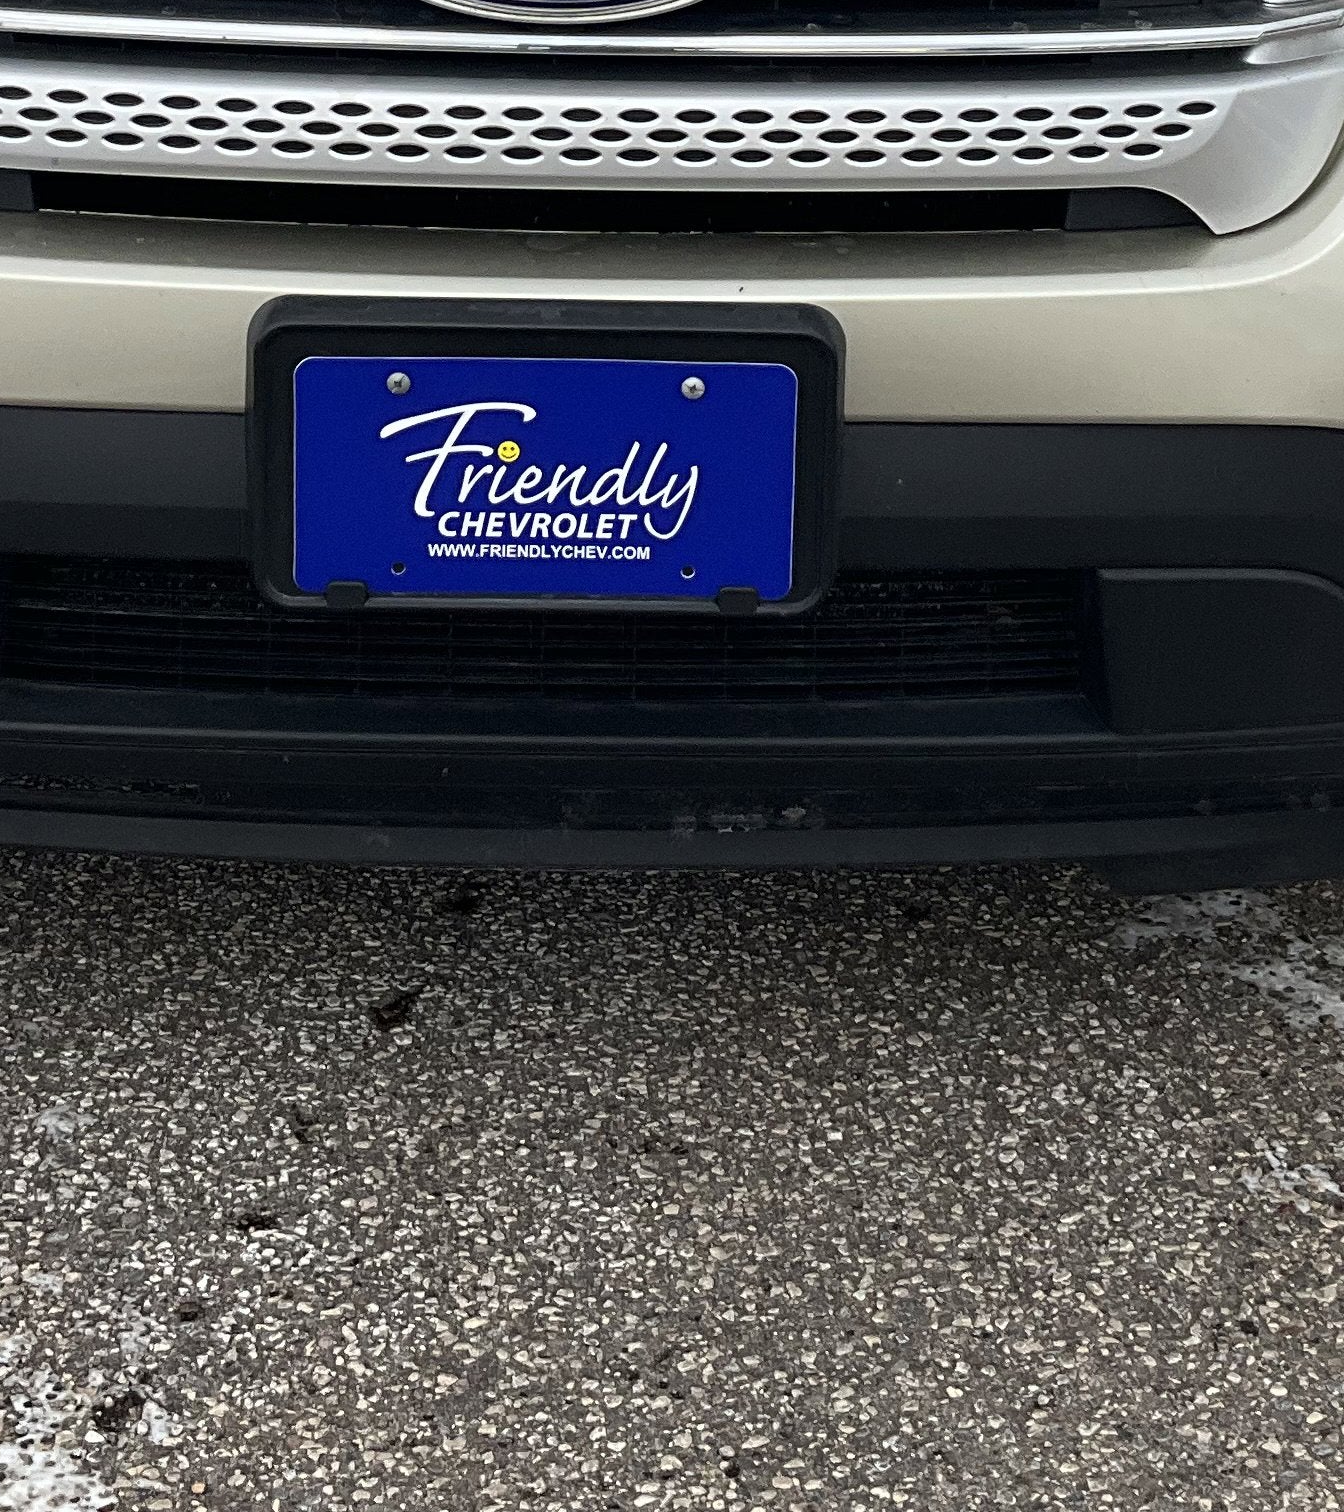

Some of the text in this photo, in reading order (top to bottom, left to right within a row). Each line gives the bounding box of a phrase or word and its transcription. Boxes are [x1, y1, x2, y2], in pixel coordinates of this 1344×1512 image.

[379, 401, 699, 540] Friendly
[437, 510, 639, 540] CHEVROLET
[427, 542, 652, 561] WWW.FRIENDLYCHEV.COM
